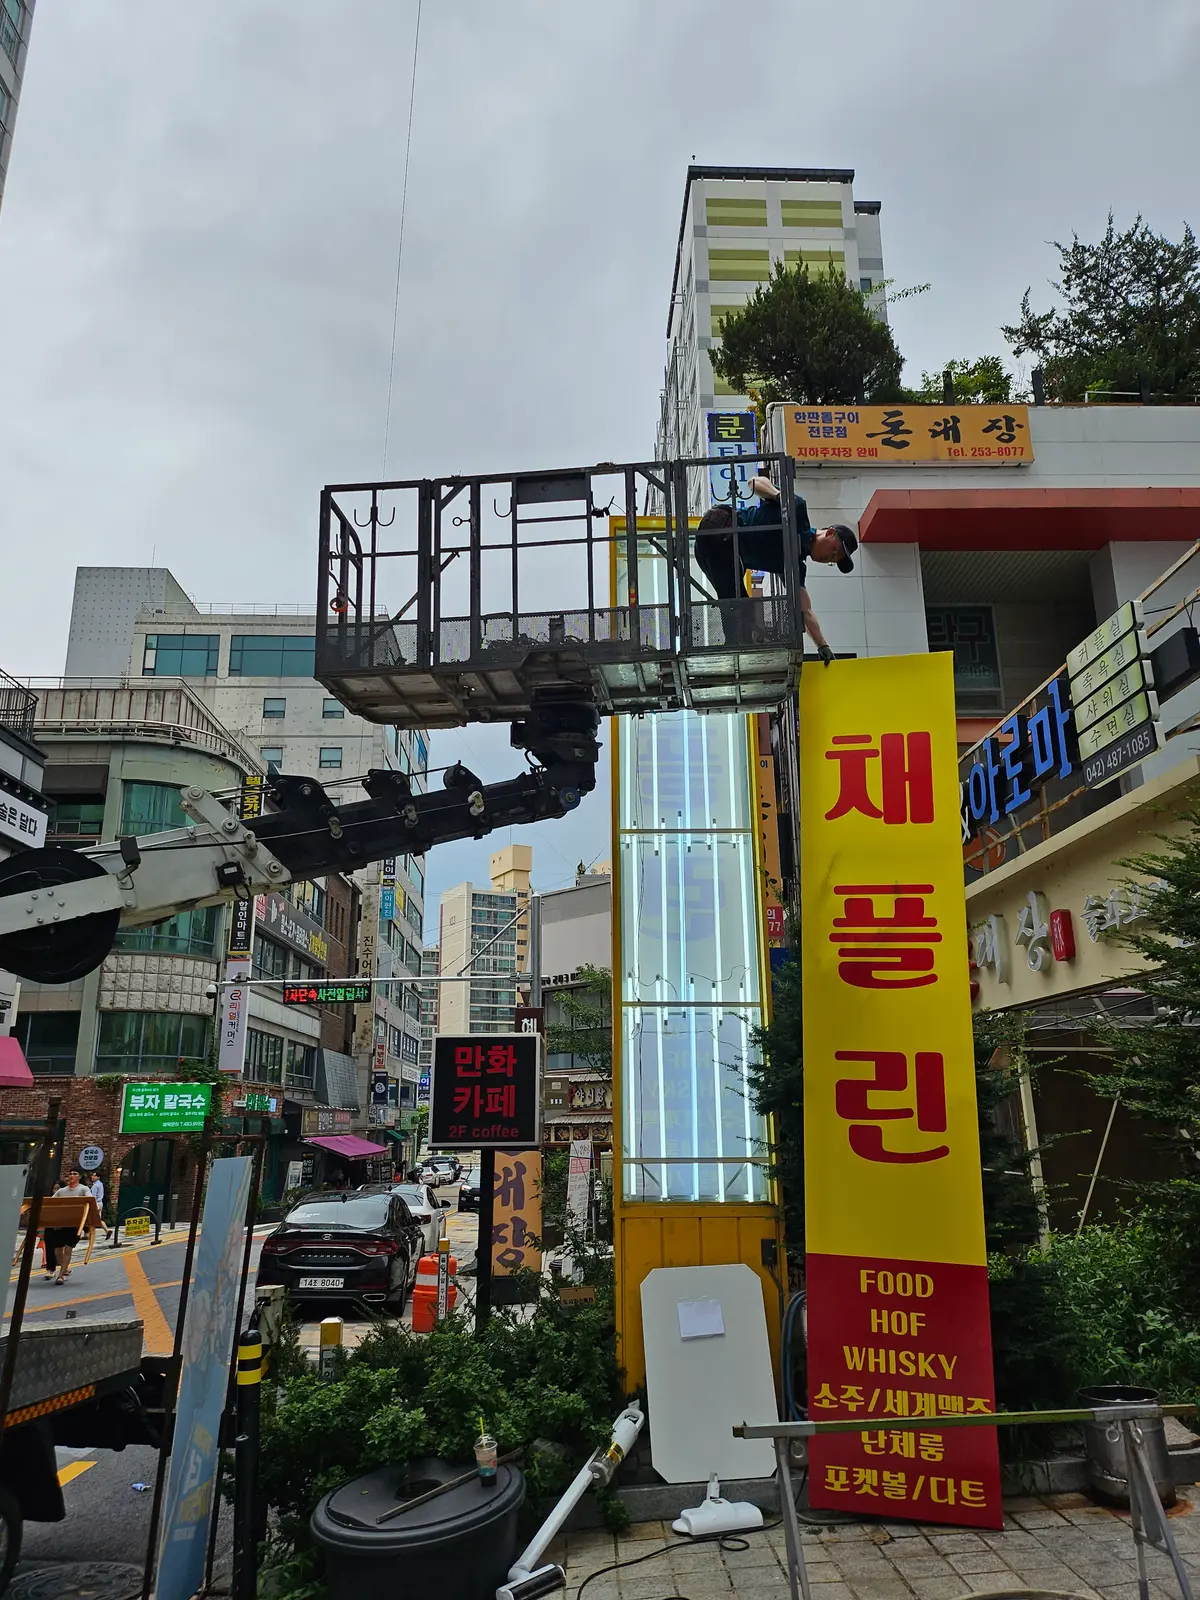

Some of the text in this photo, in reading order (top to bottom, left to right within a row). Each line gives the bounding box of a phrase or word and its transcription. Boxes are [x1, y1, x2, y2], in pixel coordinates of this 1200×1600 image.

[717, 416, 745, 438] 쿤
[808, 426, 847, 438] 전문점
[797, 447, 878, 458] 지하주차장 완비
[971, 447, 1025, 457] 253-8077
[1079, 615, 1121, 664] 커플실
[1082, 645, 1126, 691] 족욕실
[1086, 674, 1130, 718] 샤워실
[1091, 703, 1136, 748] 수면실
[969, 678, 1073, 824] 아로마
[1086, 730, 1150, 783] 042) 487-1085
[19, 812, 37, 837] 달다
[824, 731, 950, 1164] 채플린
[454, 1045, 517, 1078] 만화
[130, 1094, 206, 1110] 부자 칼국수
[453, 1084, 516, 1119] 카페
[447, 1124, 519, 1138] 2F coffee
[320, 1279, 340, 1287] 8040
[860, 1269, 934, 1298] FOOD
[870, 1308, 926, 1337] HOF
[843, 1345, 957, 1380] WHISKY
[824, 1465, 987, 1508] 포켓볼/다트
